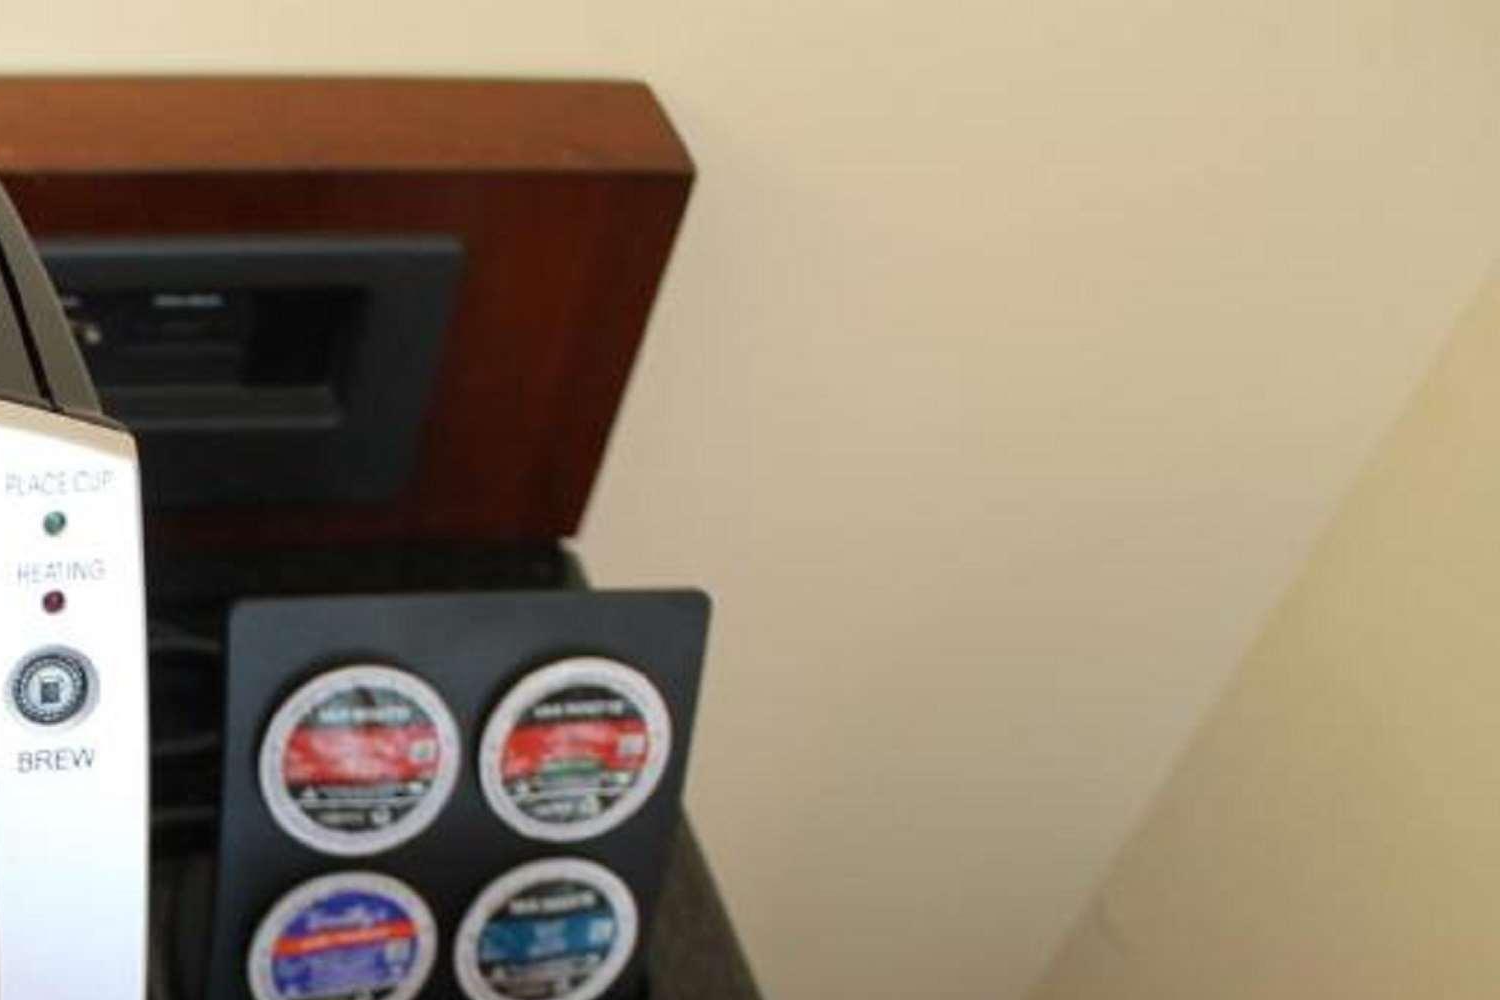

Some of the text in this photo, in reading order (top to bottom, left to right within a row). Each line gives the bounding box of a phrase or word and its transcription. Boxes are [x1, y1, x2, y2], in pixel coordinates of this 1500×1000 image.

[4, 471, 68, 497] PLACE
[16, 557, 107, 586] HEATING
[16, 747, 96, 774] BREW
